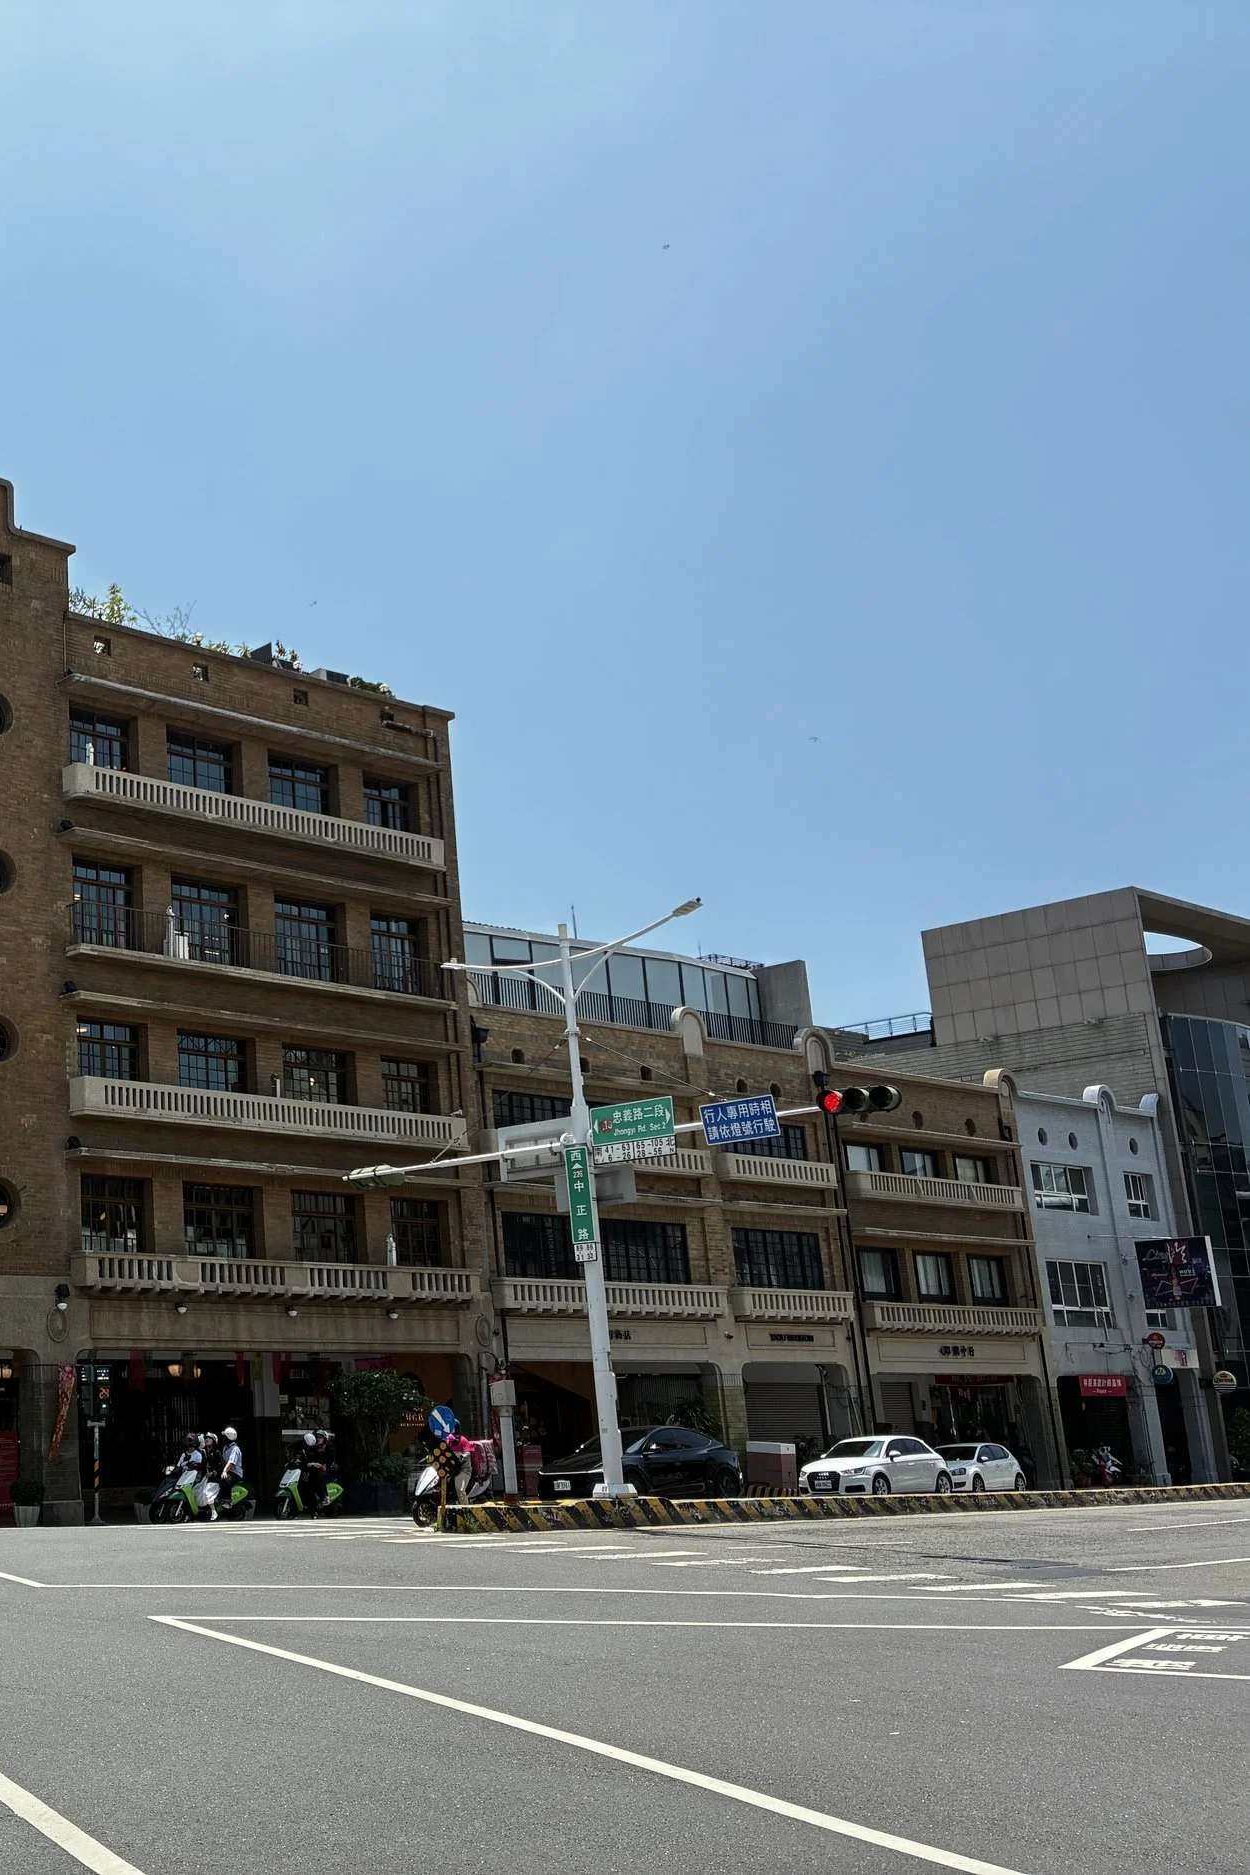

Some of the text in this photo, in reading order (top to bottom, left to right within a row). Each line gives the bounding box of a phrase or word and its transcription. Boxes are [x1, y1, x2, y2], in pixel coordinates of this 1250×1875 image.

[612, 1104, 665, 1124] 忠義路二段
[703, 1099, 773, 1124] 行人專用時相
[613, 1127, 636, 1137] Jhongyi
[707, 1117, 777, 1141] 請依燈號行駛
[570, 1150, 582, 1161] 西
[573, 1180, 590, 1240] 中正路
